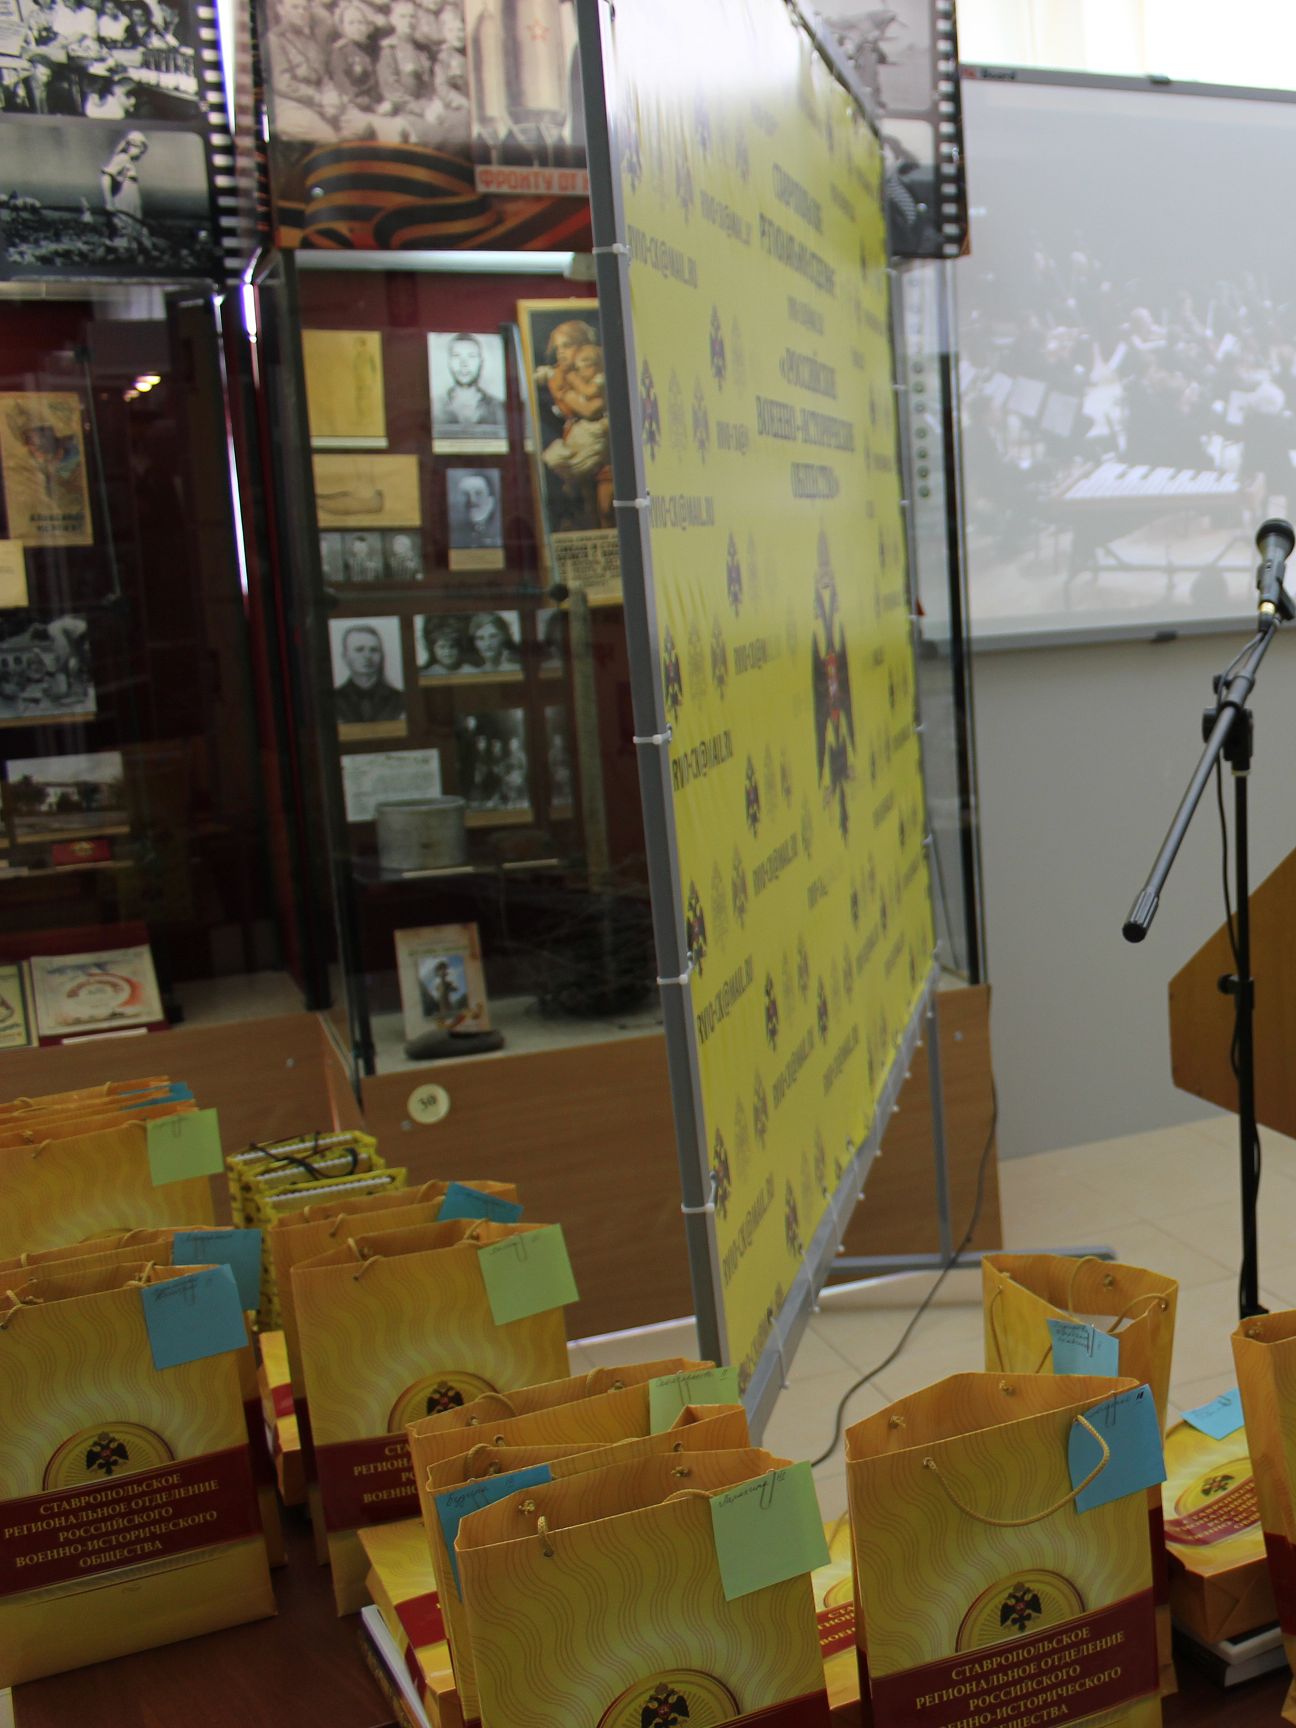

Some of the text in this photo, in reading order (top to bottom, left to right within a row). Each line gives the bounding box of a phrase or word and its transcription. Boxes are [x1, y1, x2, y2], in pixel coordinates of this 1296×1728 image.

[4, 1479, 220, 1540] РЕГИОНАЛЬНОЕ ОТДЕЛЕНИЕ
[39, 1473, 183, 1516] СТАВРОПОЛЬСКОЕ
[15, 1510, 219, 1568] ВОЕННО-ИСТОРИЧЕСКОГО
[58, 1506, 174, 1542] РОССИЙСКОГО
[79, 1540, 163, 1568] ОБЩЕСТВА
[916, 1630, 1126, 1710] РЕГИОНАЛЬНОЕ ОТДЕЛЕНИЕ
[951, 1626, 1092, 1680] СТАВРОПОЛЬСКОЕ
[969, 1664, 1081, 1711] РОССИЙСКОГО
